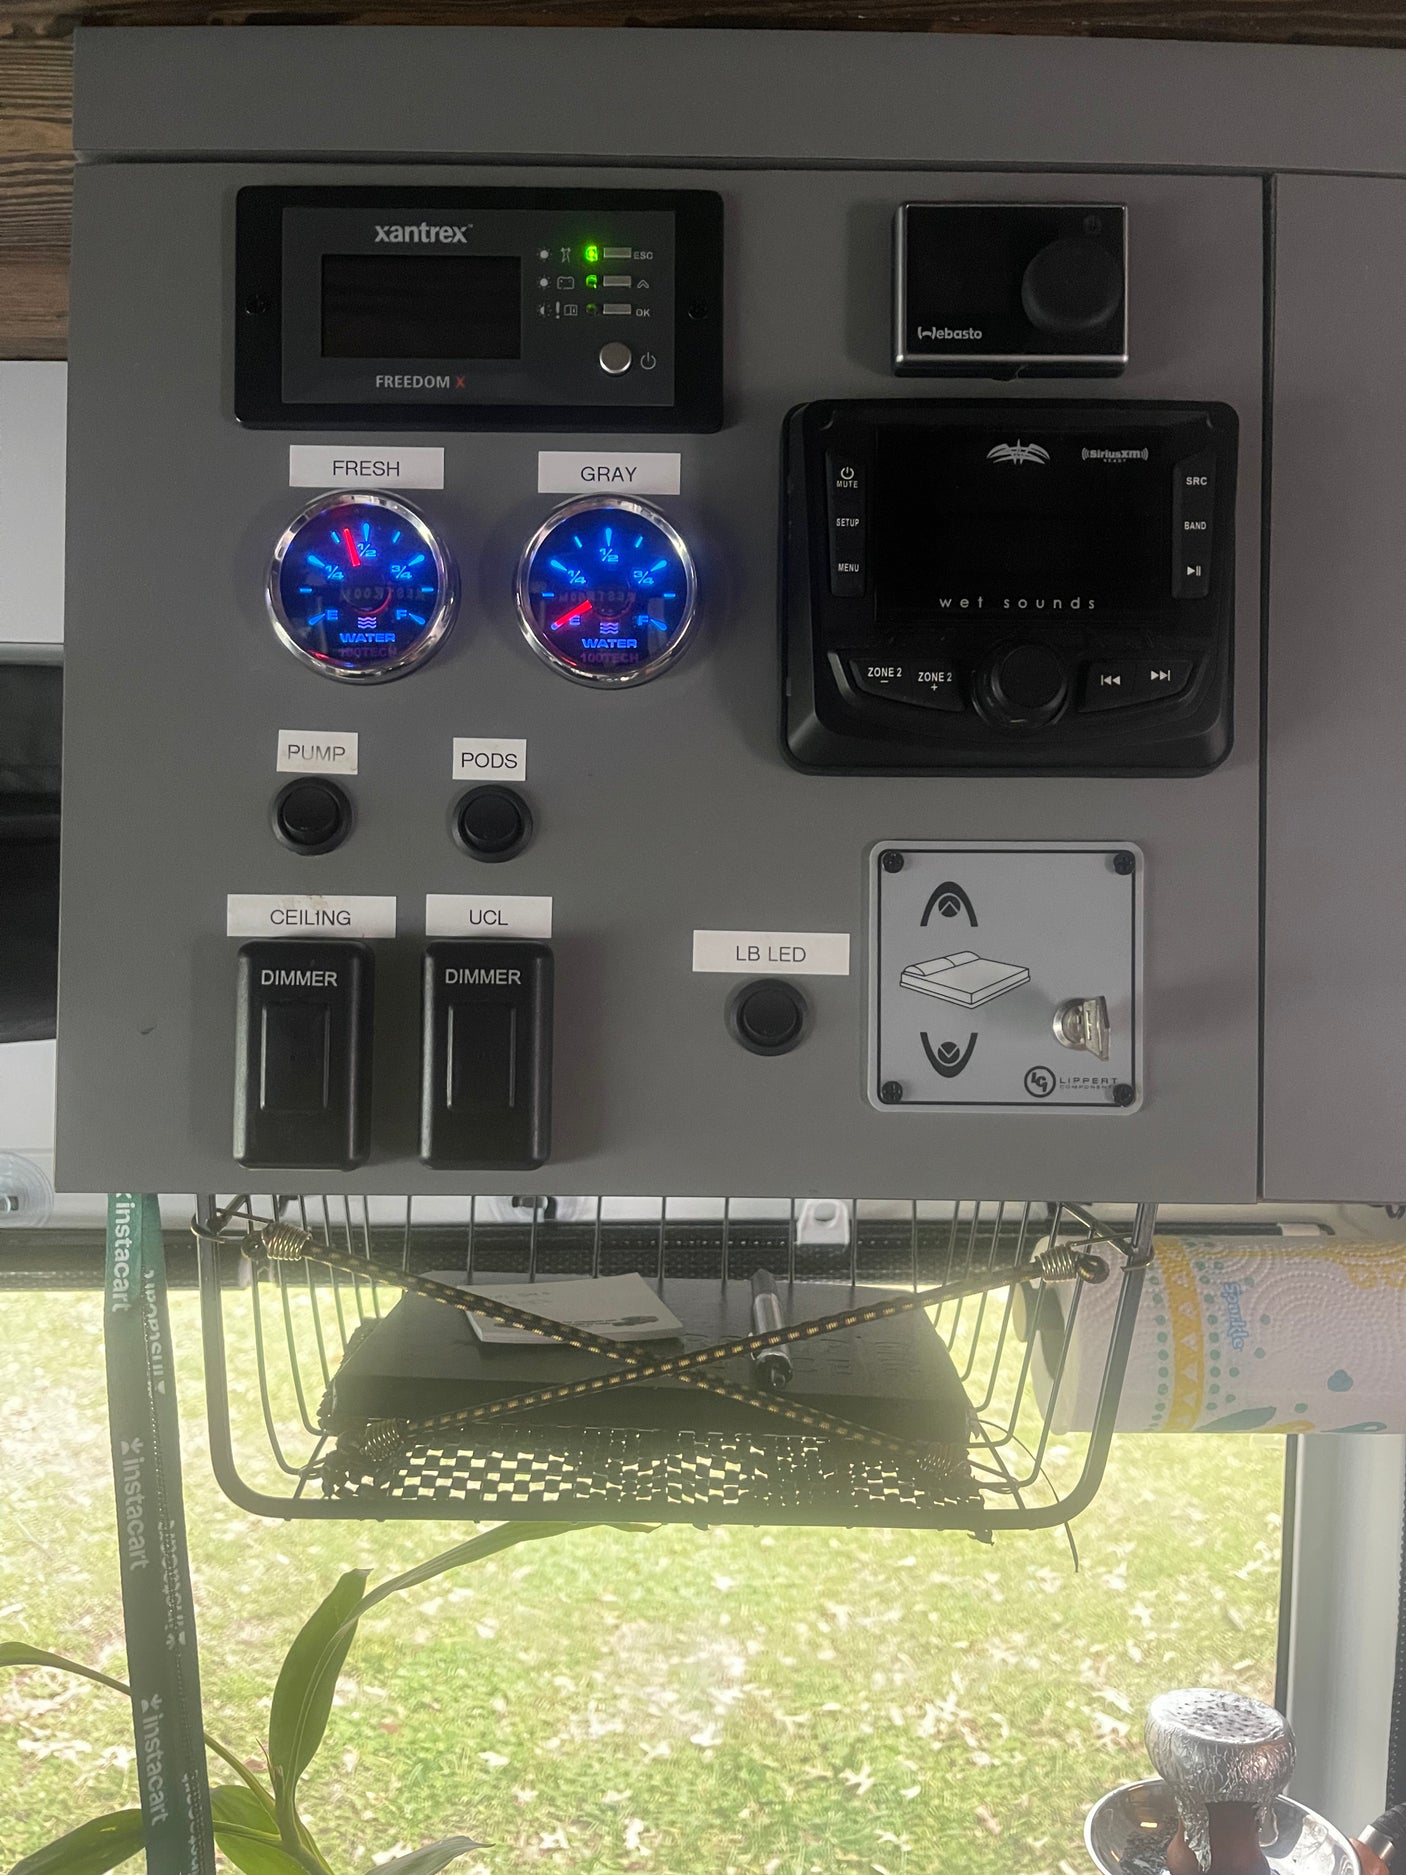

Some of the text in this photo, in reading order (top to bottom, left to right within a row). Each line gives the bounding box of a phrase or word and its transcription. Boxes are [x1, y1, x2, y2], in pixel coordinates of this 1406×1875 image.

[374, 221, 468, 243] xantrex
[633, 251, 653, 260] ESC
[635, 308, 650, 317] OK
[375, 375, 465, 389] FREEDOM X
[333, 460, 400, 477] FRESH
[580, 466, 638, 482] GRAY
[836, 480, 858, 489] MUTE
[1186, 476, 1208, 486] SRC
[836, 518, 860, 528] SETUP
[1184, 521, 1207, 530] BAND
[838, 563, 860, 573] MENU
[939, 595, 1096, 610] wet sounds
[325, 609, 338, 621] E
[396, 609, 408, 621] F
[637, 615, 649, 626] F
[339, 632, 396, 643] WATER
[581, 638, 638, 649] WATER
[867, 667, 903, 678] ZONE 2
[917, 671, 953, 682] ZONE 2
[287, 744, 346, 762] PUMP
[461, 752, 518, 769] PODS
[270, 909, 352, 926] CEILING
[469, 909, 509, 926] UCL
[736, 945, 807, 963] LB LED
[261, 969, 338, 987] DIMMER
[445, 968, 522, 985] DIMMER
[1059, 1077, 1118, 1085] LIPPERT
[111, 1202, 135, 1313] instacart
[1221, 1282, 1249, 1351] Sparkle
[122, 1456, 150, 1571] instacart
[142, 1713, 168, 1826] instacart
